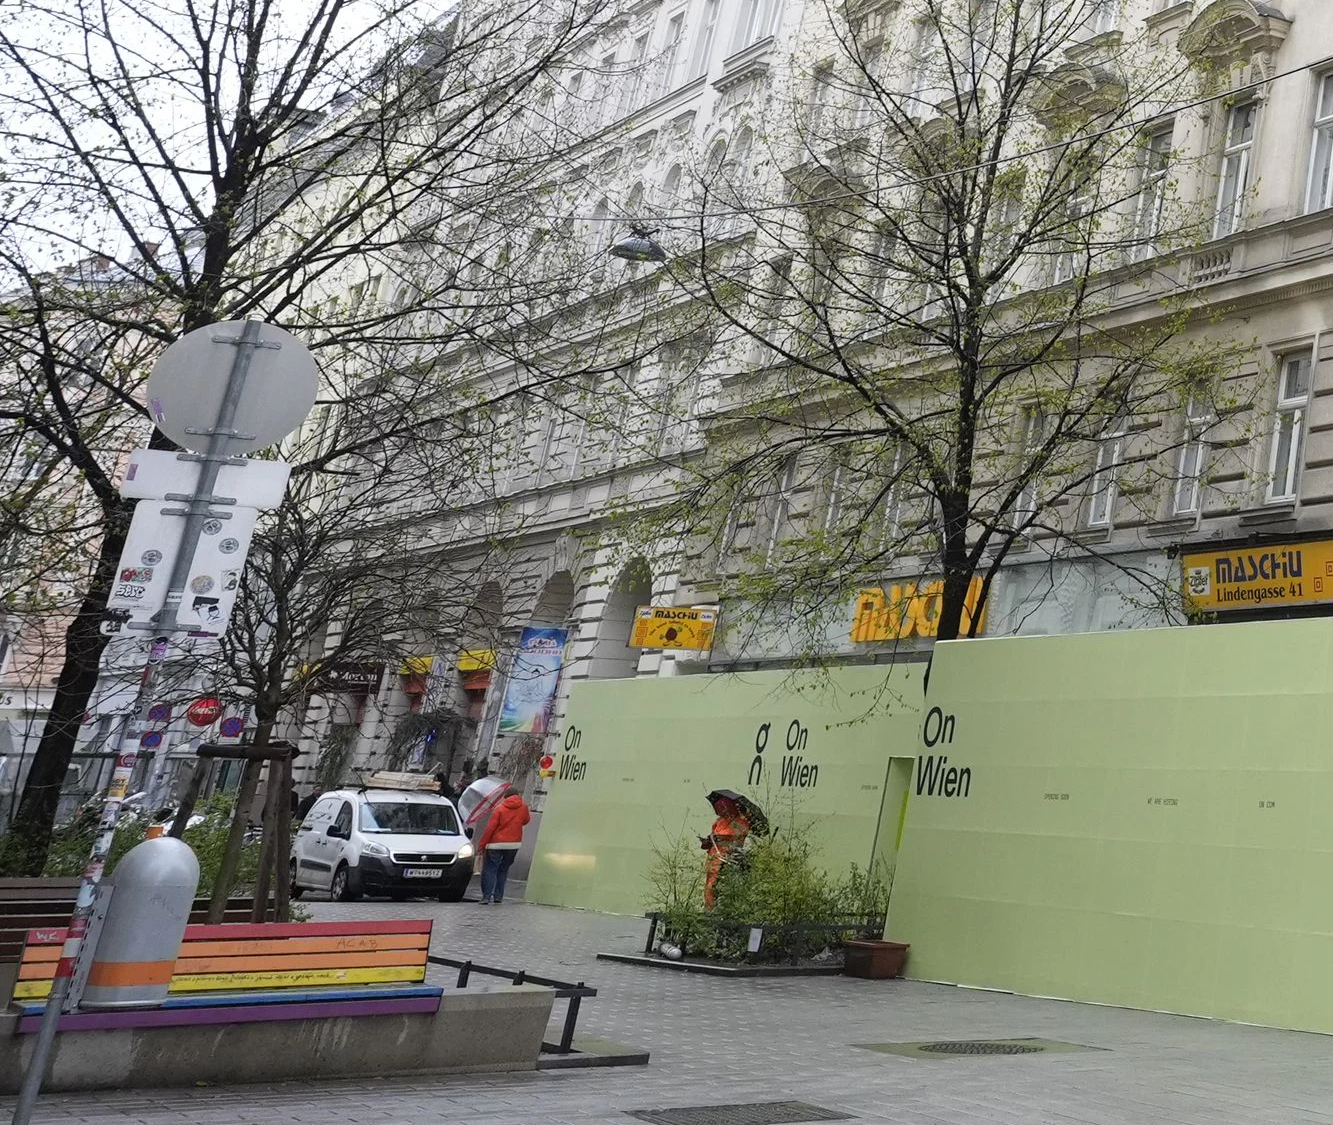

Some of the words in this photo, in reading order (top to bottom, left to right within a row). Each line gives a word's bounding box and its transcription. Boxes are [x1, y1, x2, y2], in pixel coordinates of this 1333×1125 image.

[1216, 585, 1286, 604] Lindengasse
[1288, 582, 1303, 597] 41
[564, 724, 582, 752] On
[786, 719, 808, 751] On
[923, 705, 956, 749] On
[559, 754, 587, 782] Wien
[780, 755, 819, 788] Wien
[915, 755, 971, 799] Wien
